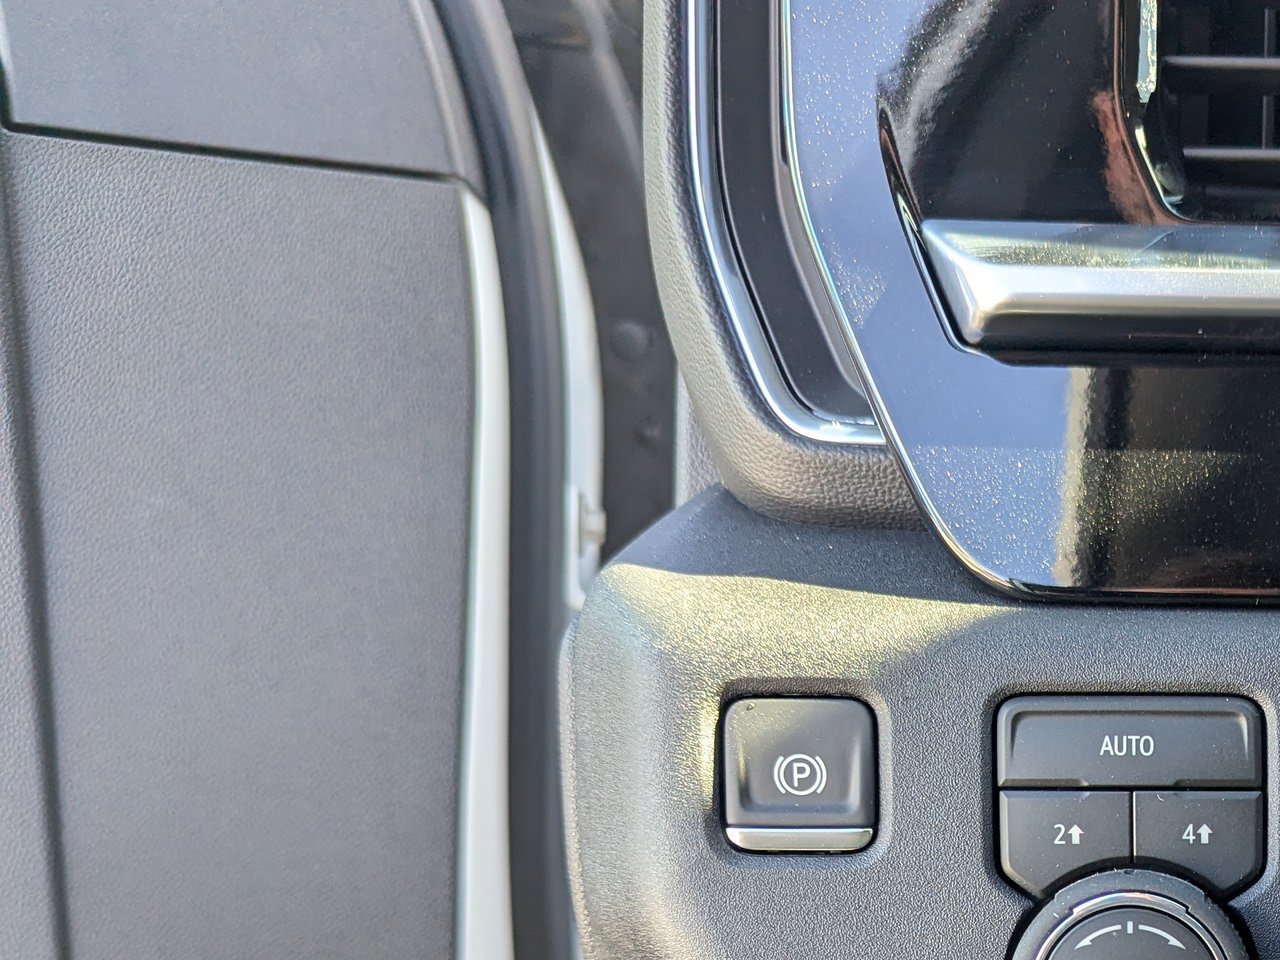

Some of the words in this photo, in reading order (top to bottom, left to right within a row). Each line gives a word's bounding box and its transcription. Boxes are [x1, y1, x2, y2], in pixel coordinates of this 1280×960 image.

[1099, 735, 1155, 756] AUTO
[792, 762, 811, 788] P
[1053, 823, 1066, 845] 2
[1182, 823, 1196, 844] 4
